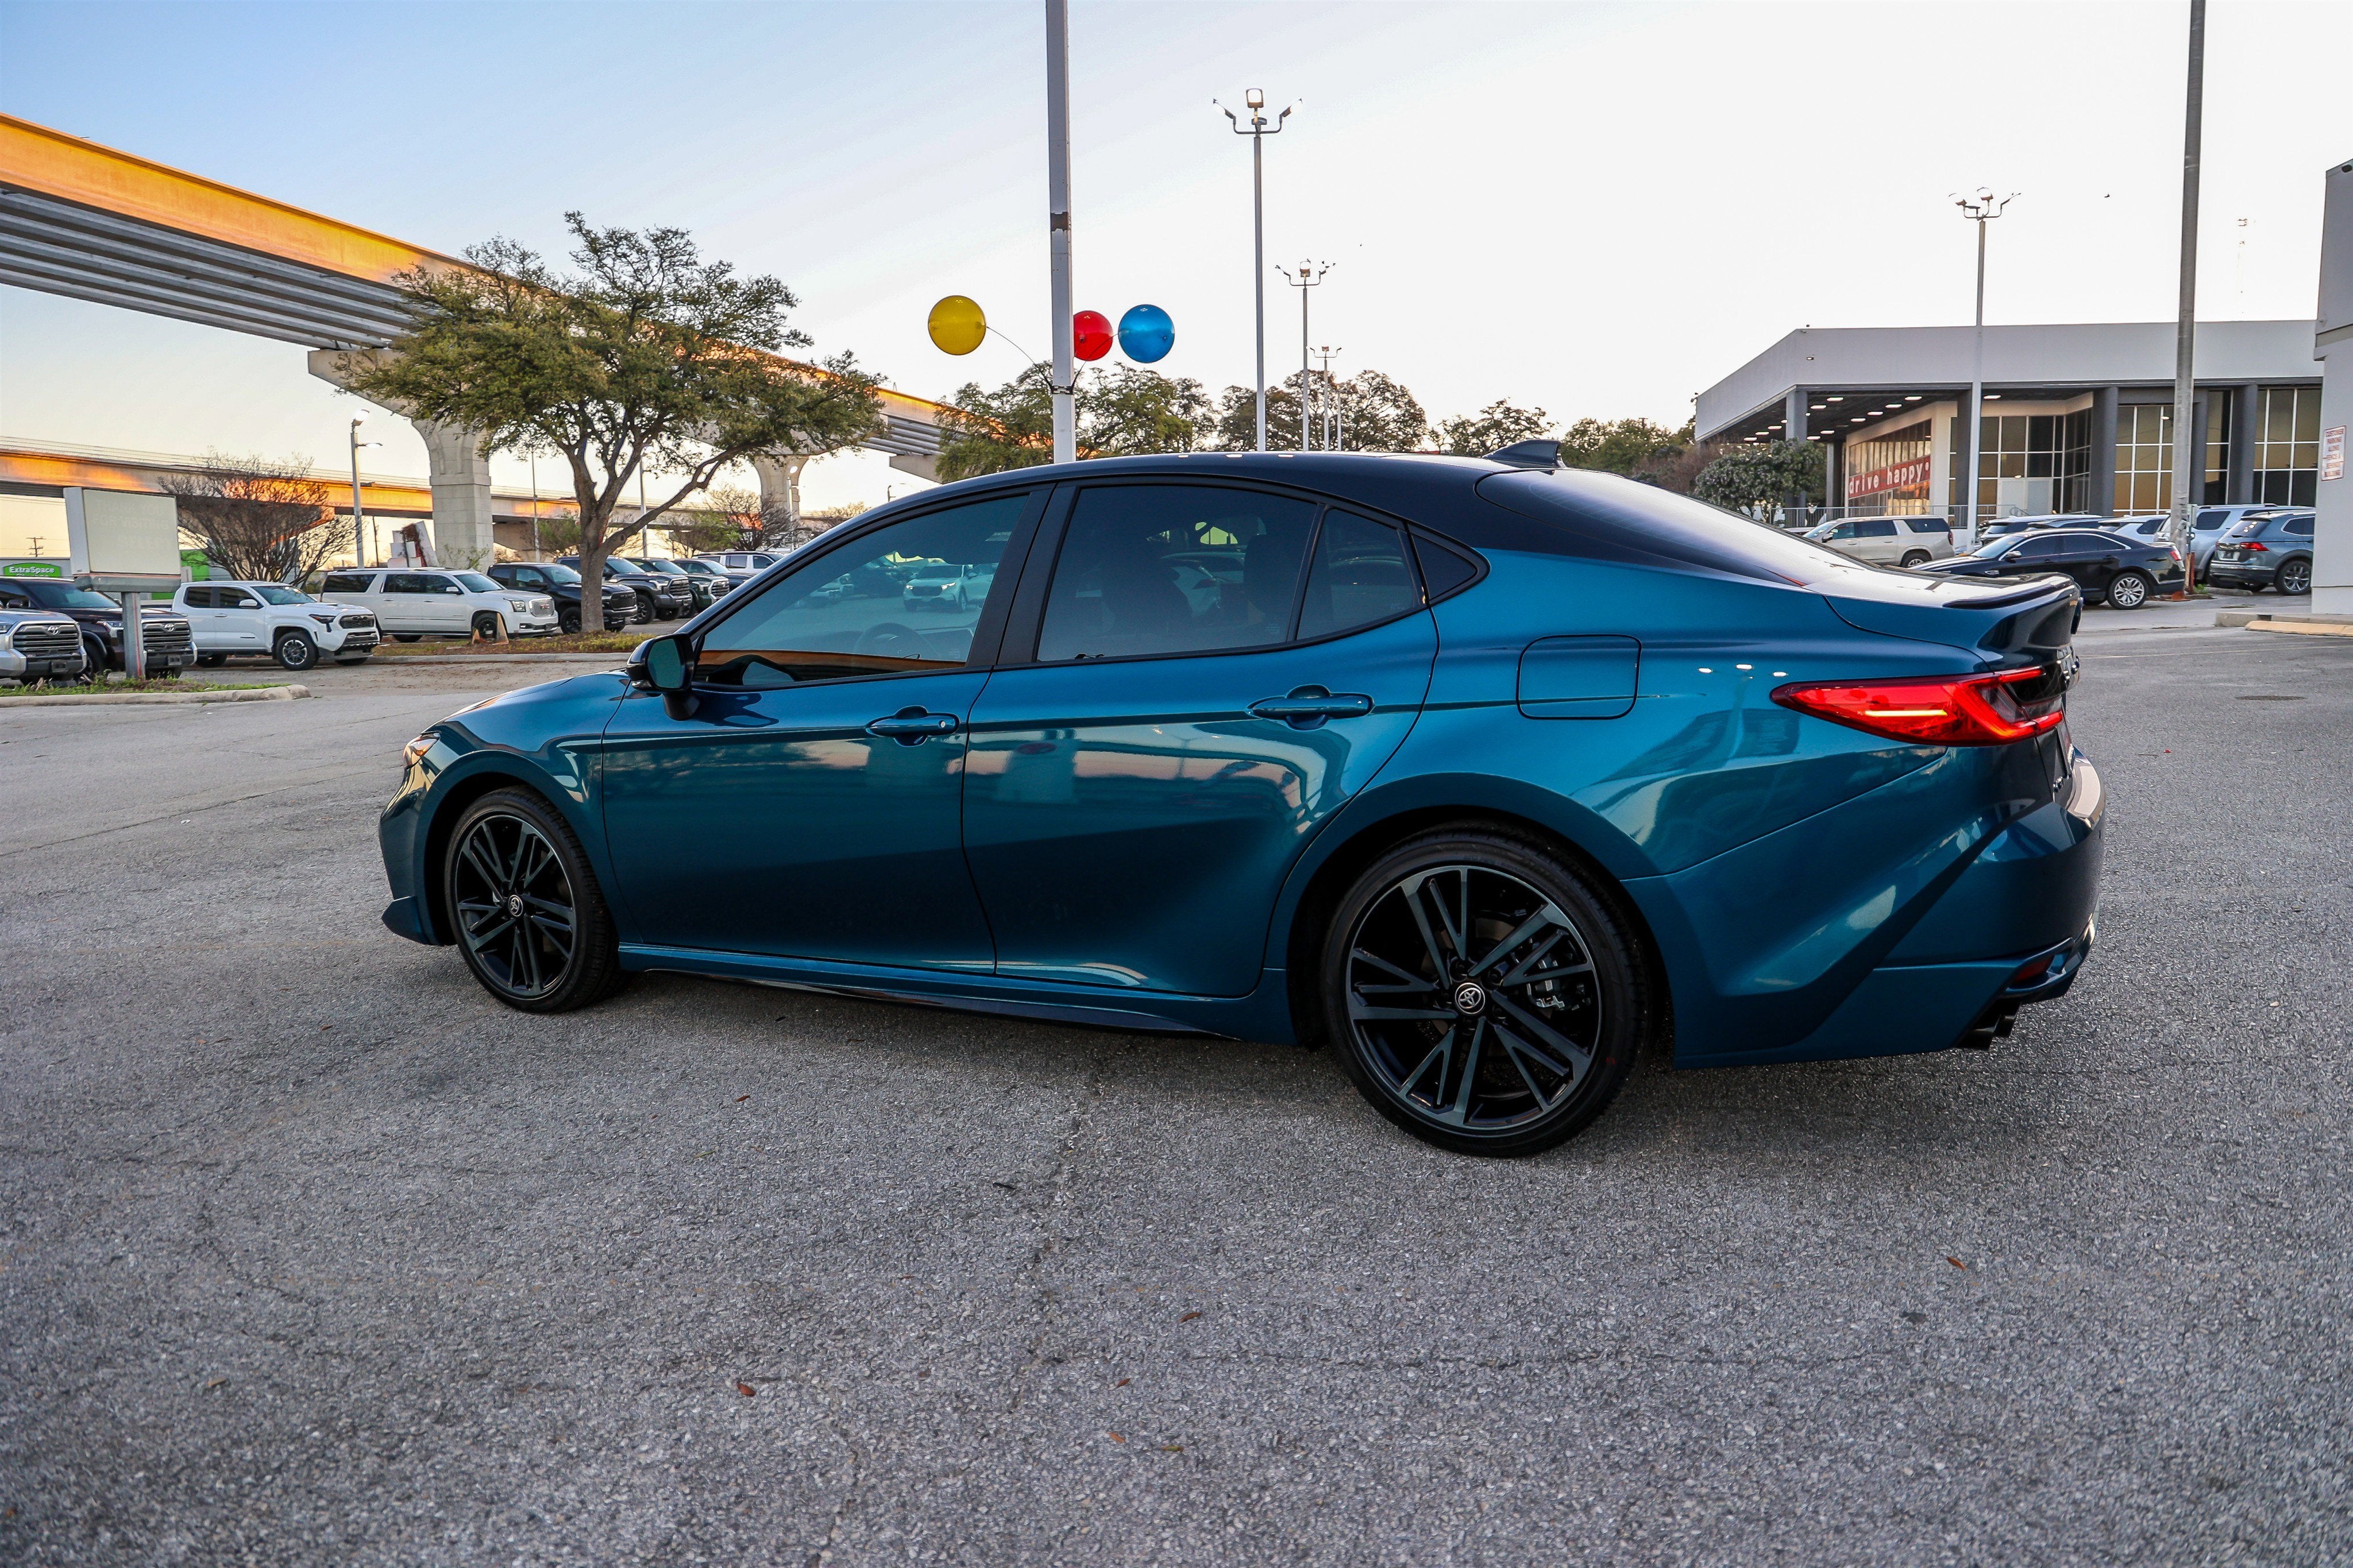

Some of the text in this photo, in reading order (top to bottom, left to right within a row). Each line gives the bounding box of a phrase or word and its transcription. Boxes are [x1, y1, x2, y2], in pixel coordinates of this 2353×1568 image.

[1849, 463, 1923, 494] drive happy
[140, 503, 164, 516] YOU
